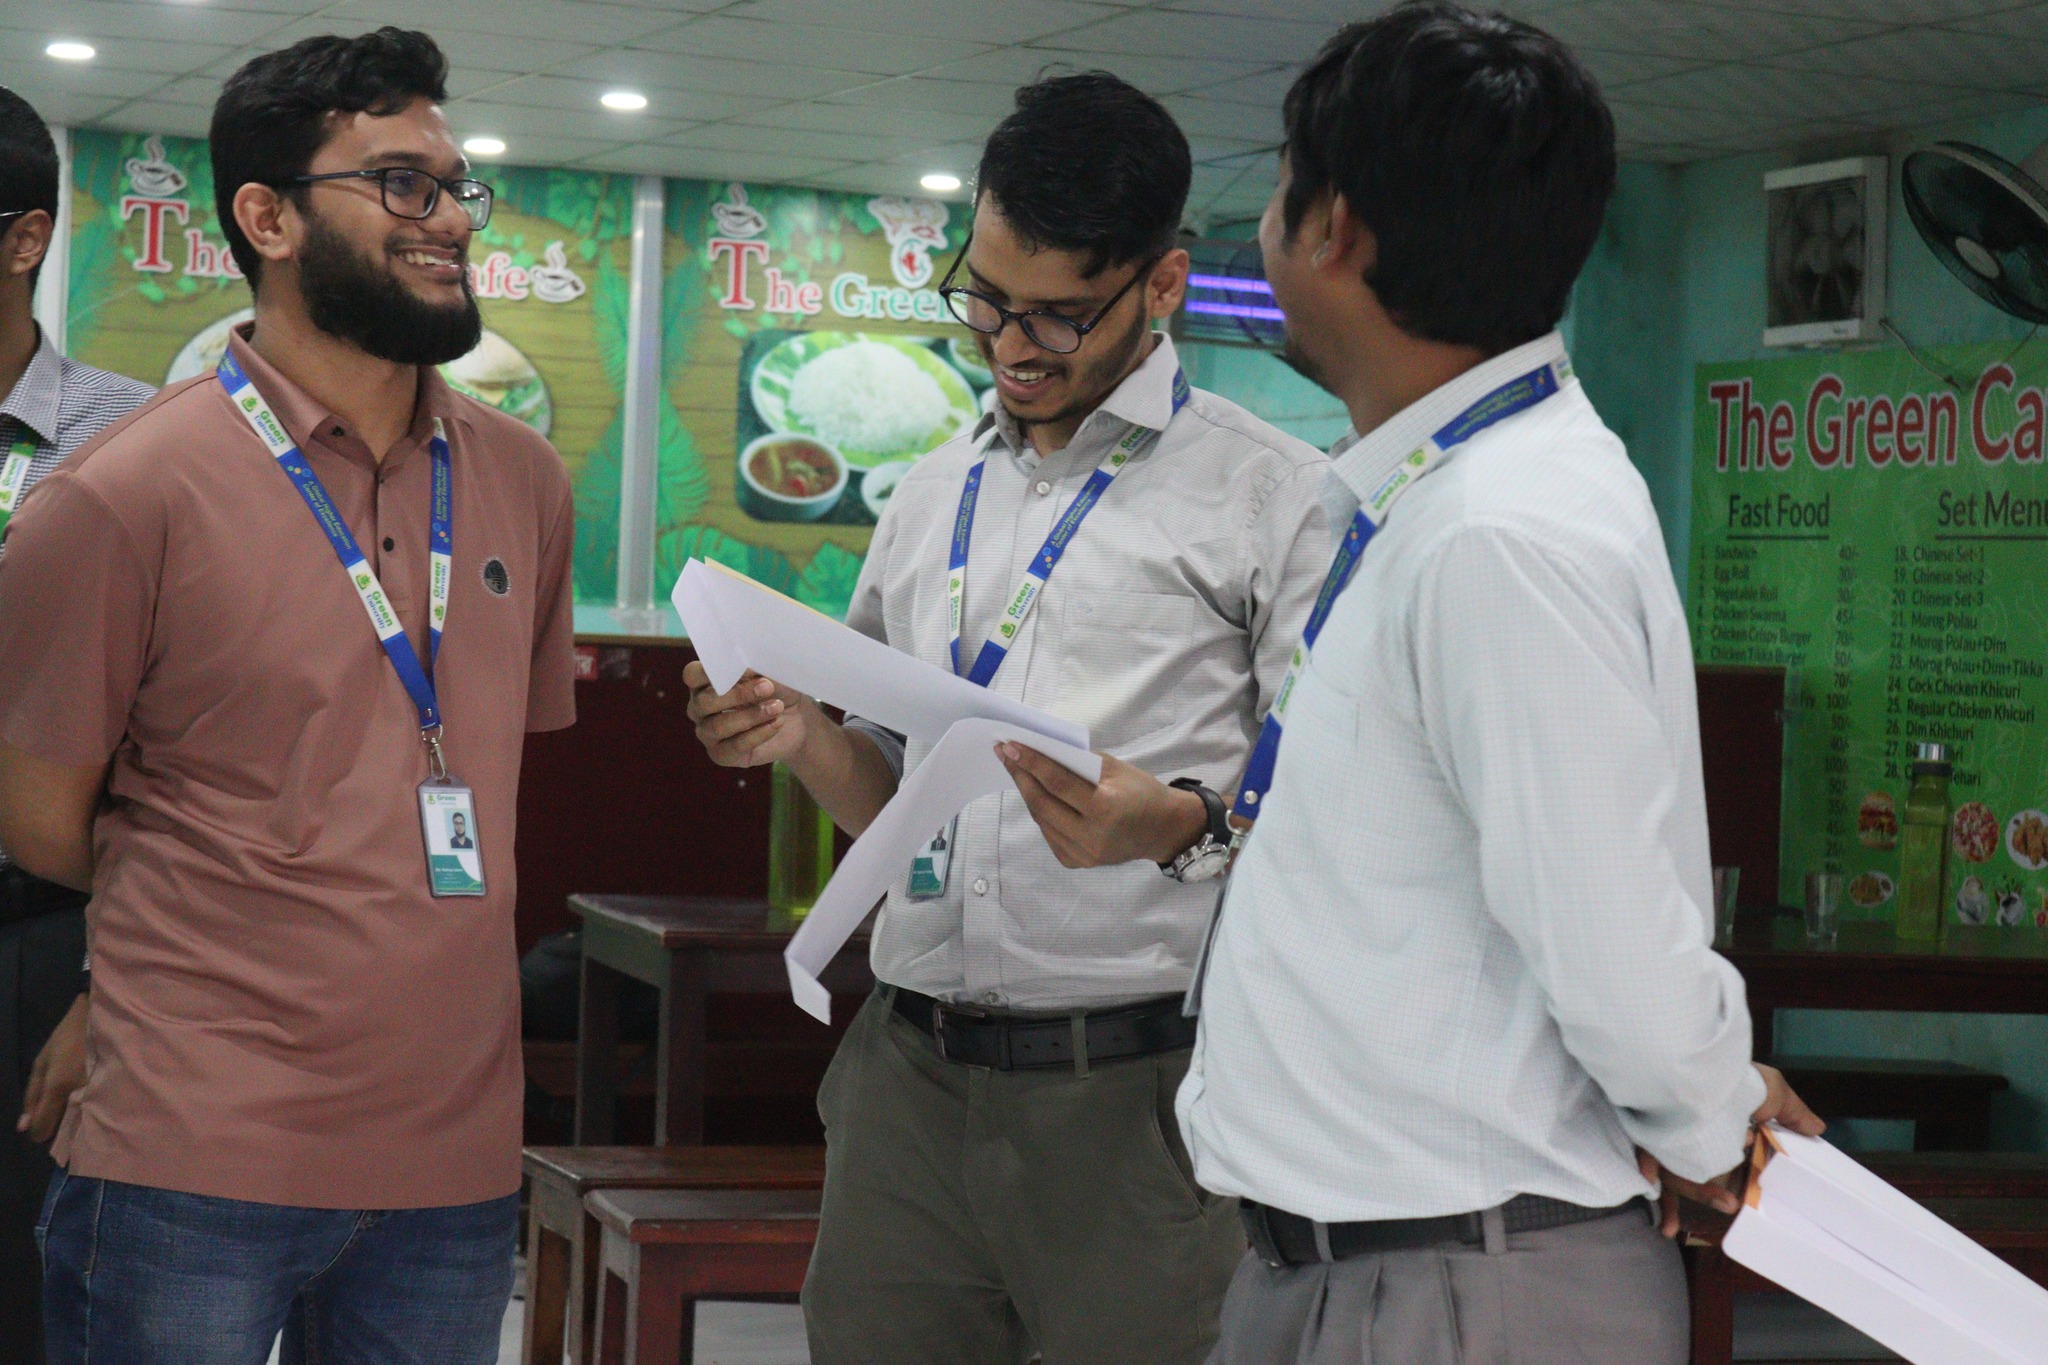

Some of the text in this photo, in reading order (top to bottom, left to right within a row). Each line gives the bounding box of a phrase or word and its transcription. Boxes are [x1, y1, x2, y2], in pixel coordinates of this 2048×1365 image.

[708, 238, 823, 315] The
[260, 410, 286, 444] Green
[1709, 362, 2048, 472] The Green Ca
[1728, 493, 1830, 528] Fast Food
[1937, 491, 1976, 527] Set
[1913, 545, 1954, 562] Chinese
[433, 562, 441, 598] Green
[1913, 567, 1953, 584] Chinese
[366, 594, 386, 629] University
[372, 590, 393, 627] Green
[1007, 582, 1031, 616] Green
[1015, 587, 1036, 619] University
[1912, 589, 1952, 606] Chinese
[1947, 611, 1977, 629] Polau
[1908, 677, 1933, 694] Cock
[1935, 678, 1978, 697] Chicken
[1907, 698, 1946, 719] Regular
[1948, 700, 1992, 720] Chicken
[1906, 720, 1927, 736] Dim
[1929, 721, 1974, 741] Khichuri
